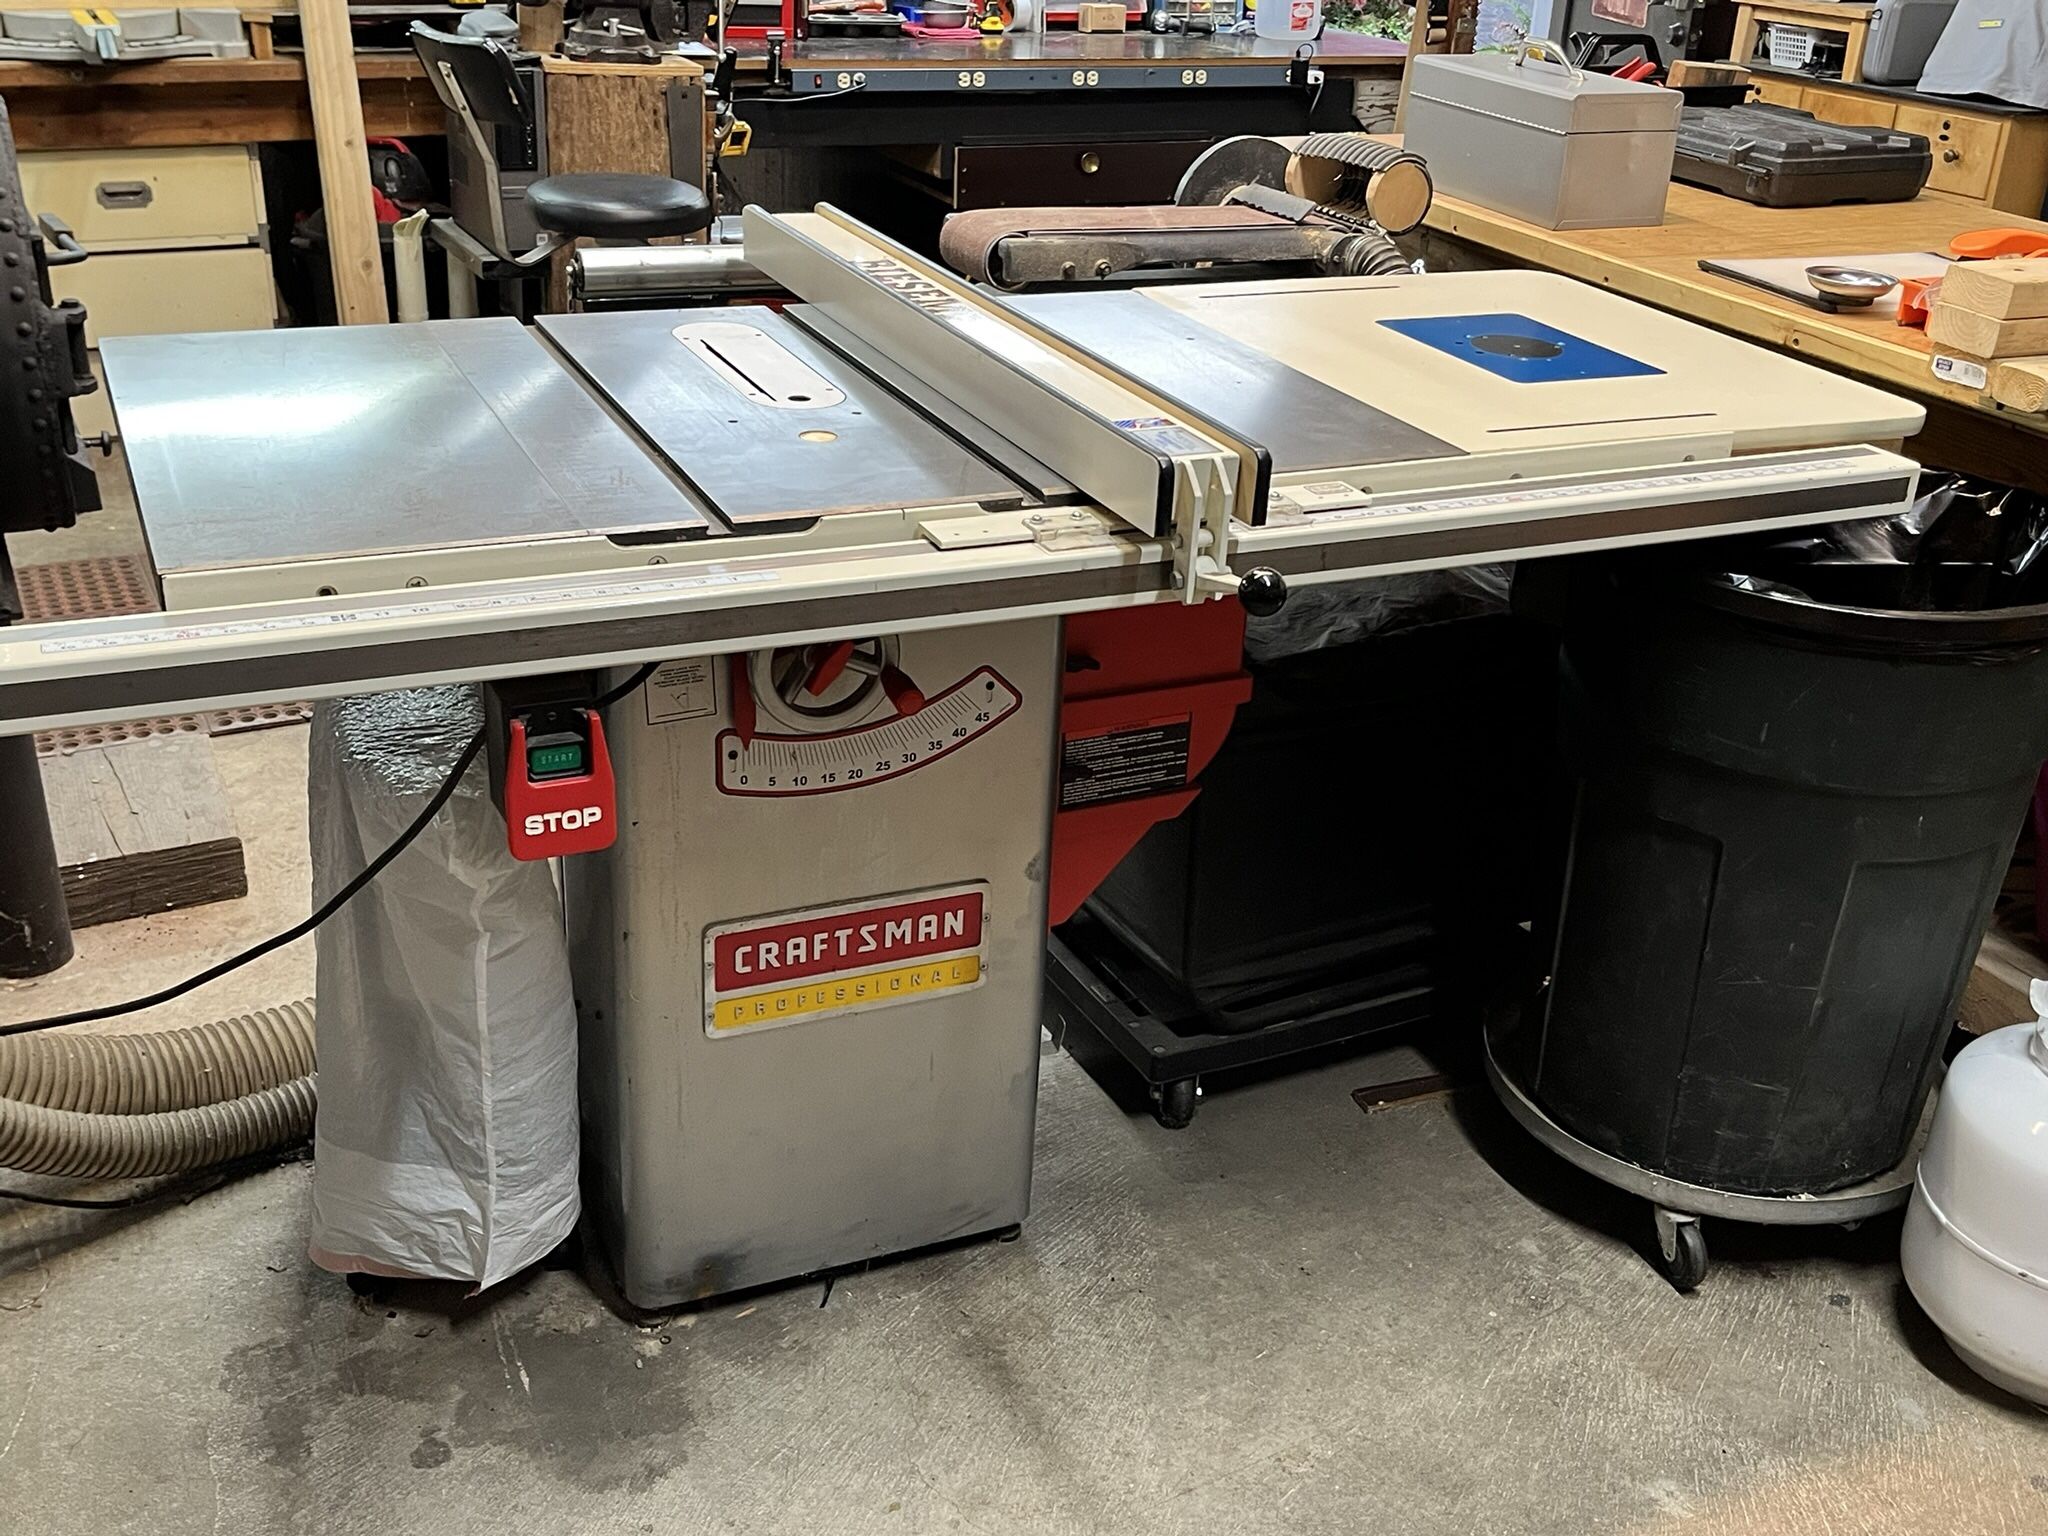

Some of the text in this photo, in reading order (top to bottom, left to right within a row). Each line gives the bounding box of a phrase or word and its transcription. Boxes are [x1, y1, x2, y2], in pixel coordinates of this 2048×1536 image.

[541, 753, 573, 765] START
[739, 711, 990, 787] 0 5 10 15 20 25 30 35 40 45
[524, 806, 602, 836] STOP
[734, 908, 965, 975] CRAFTSMAN
[733, 965, 962, 1020] PROFESSIONAL
